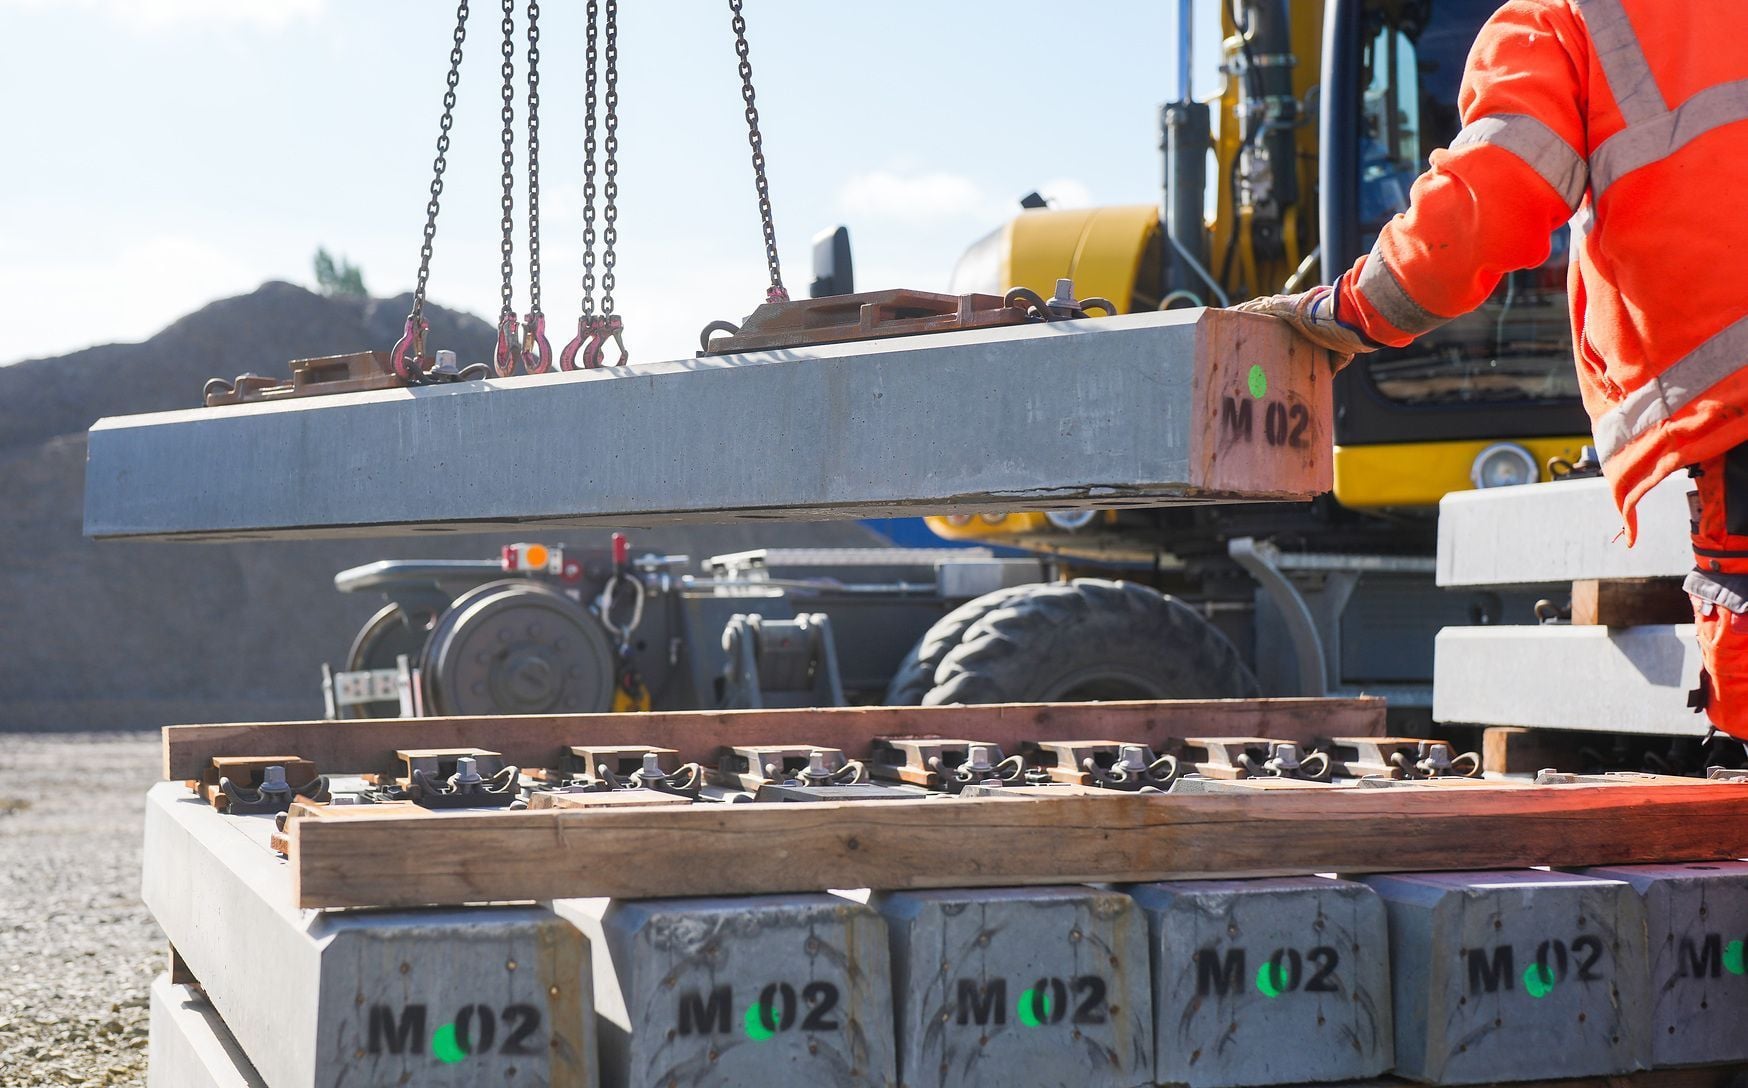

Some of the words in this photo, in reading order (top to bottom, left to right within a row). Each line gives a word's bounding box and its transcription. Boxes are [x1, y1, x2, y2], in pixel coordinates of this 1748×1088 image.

[1222, 397, 1252, 442] M
[1265, 402, 1311, 449] 02
[1199, 948, 1245, 996] M
[1270, 946, 1340, 994] 02
[1467, 945, 1514, 993] M
[1536, 935, 1602, 986] 02
[1679, 933, 1721, 978] M
[677, 986, 732, 1034] M
[758, 982, 839, 1032] 02
[956, 978, 1006, 1026] M
[1031, 976, 1107, 1026] 02
[367, 1005, 427, 1056] M
[454, 1004, 542, 1056] 02
